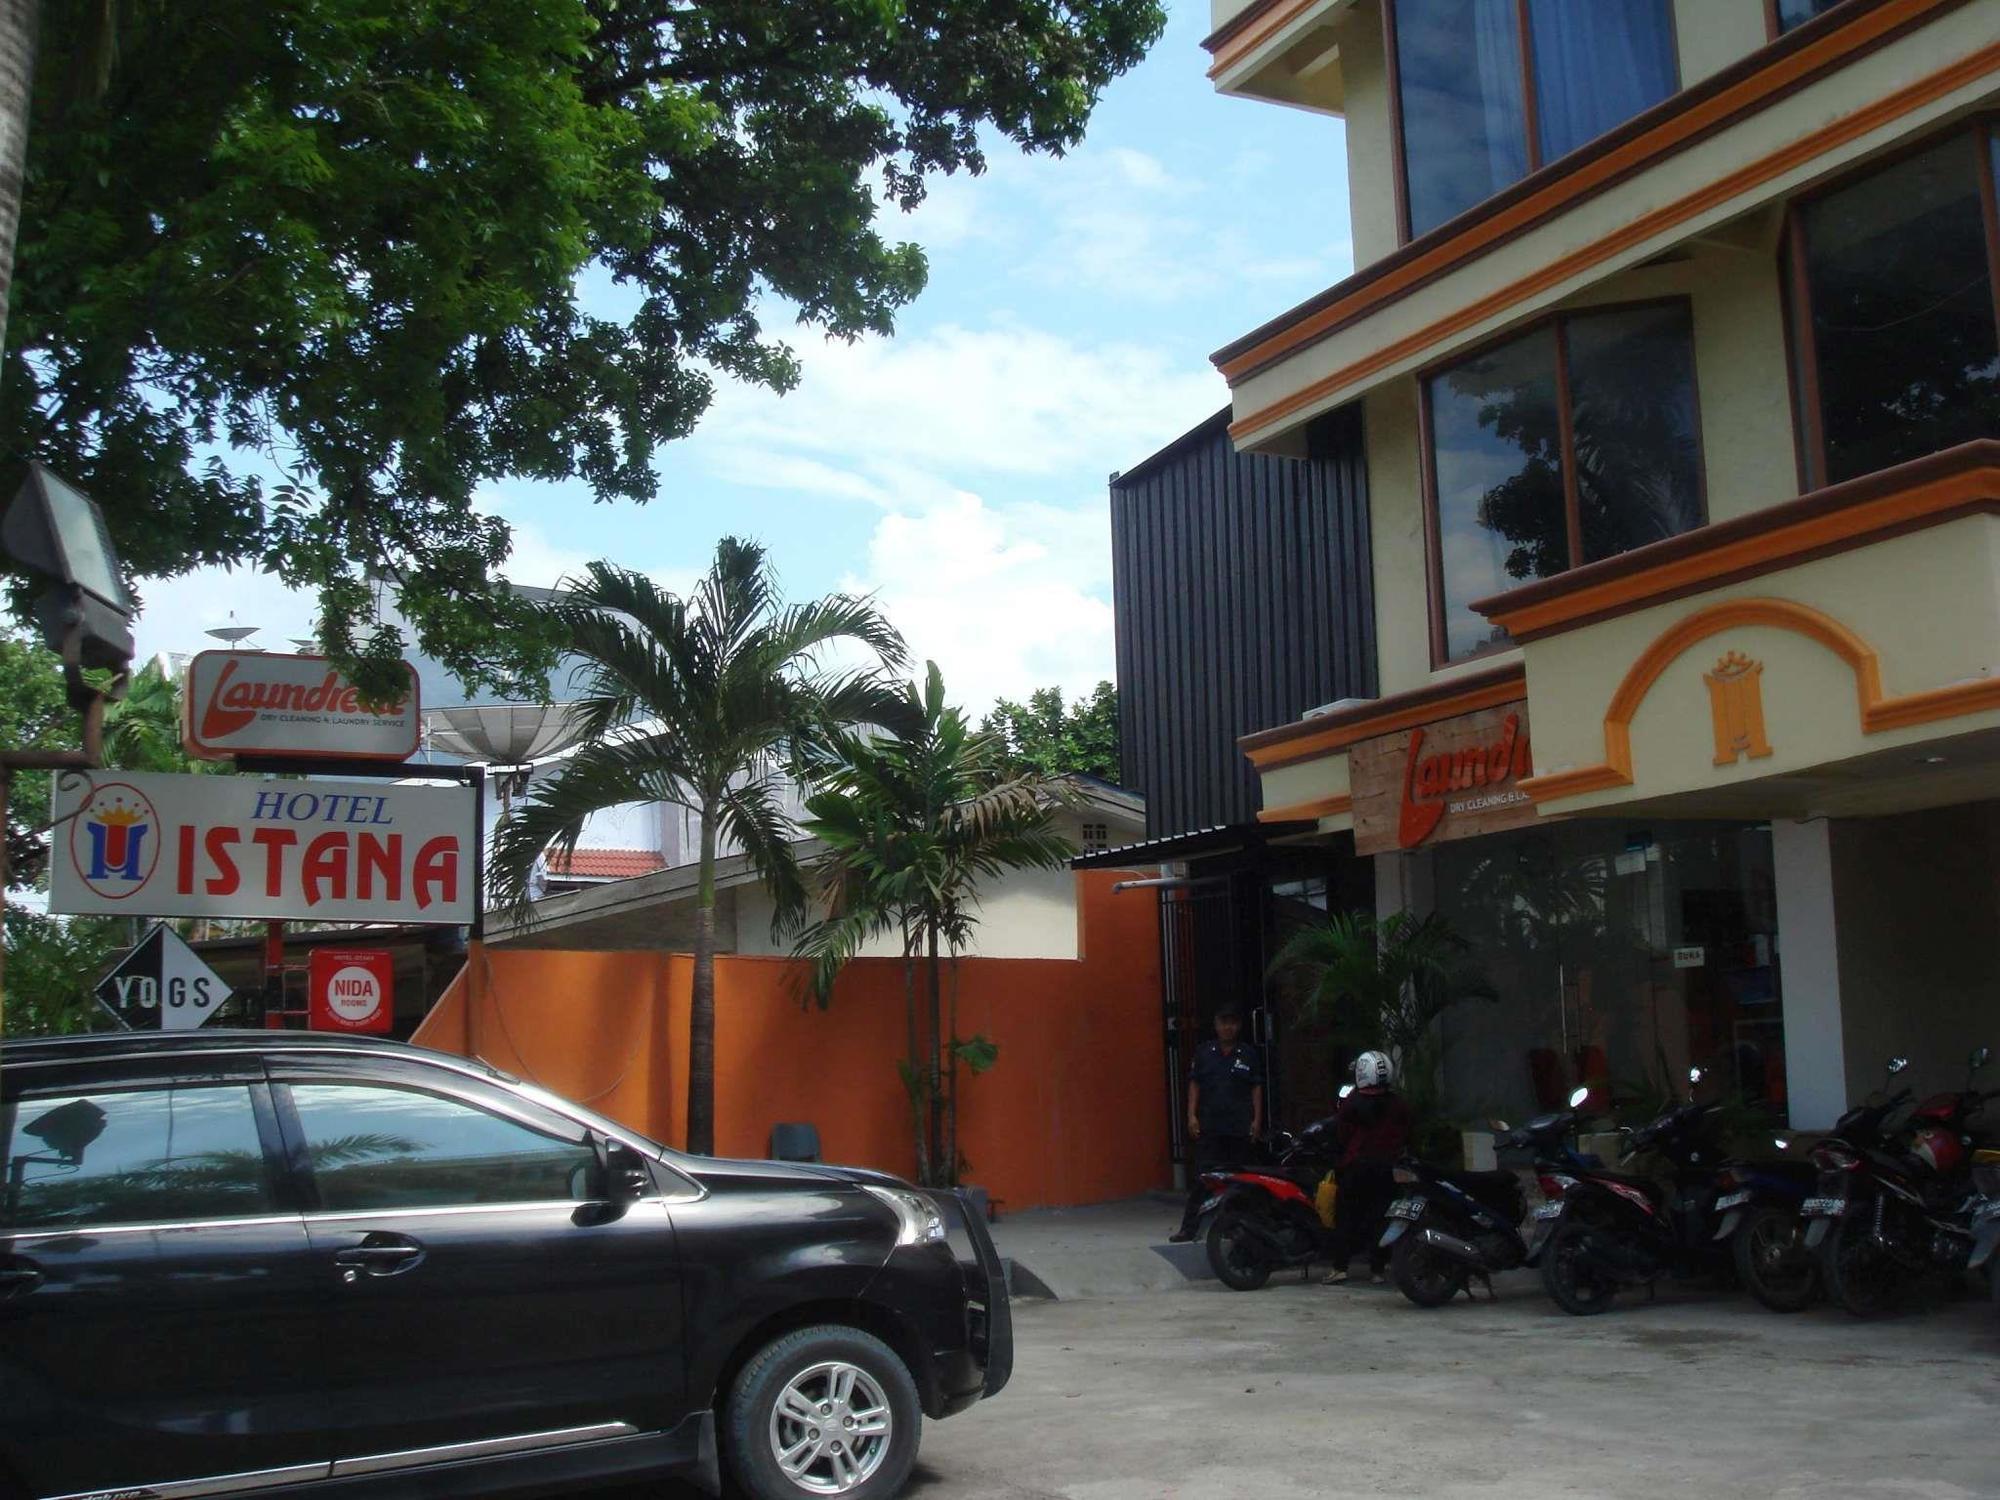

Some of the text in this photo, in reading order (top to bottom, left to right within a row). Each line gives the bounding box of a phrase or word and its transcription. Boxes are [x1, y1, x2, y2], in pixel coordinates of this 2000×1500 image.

[280, 714, 321, 724] CLEANING
[332, 717, 370, 726] LAUNDRY
[252, 790, 393, 825] HOTEL
[1466, 794, 1507, 811] CLEANING
[177, 825, 460, 910] ISTANA
[114, 975, 211, 1009] YOGS
[334, 979, 374, 997] NIDA
